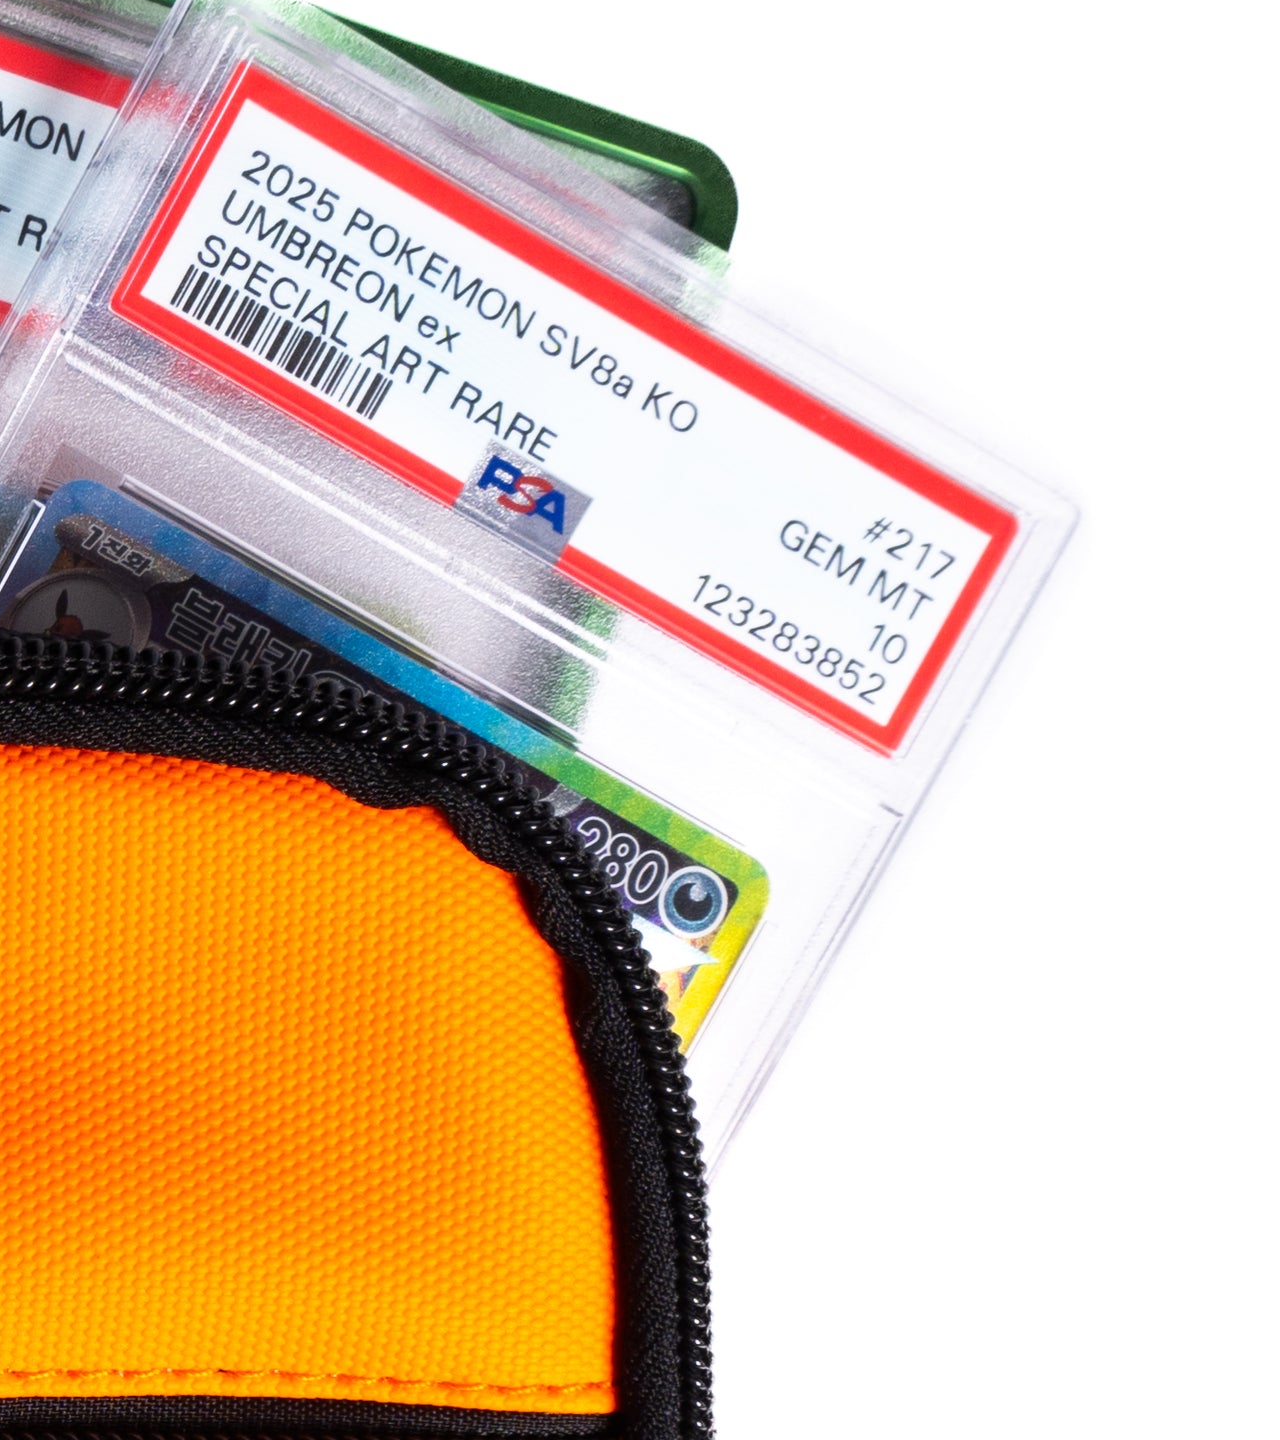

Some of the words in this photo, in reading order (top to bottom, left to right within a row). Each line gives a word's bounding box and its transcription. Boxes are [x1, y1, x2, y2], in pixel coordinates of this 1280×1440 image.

[221, 190, 415, 323] UMBREON
[416, 309, 462, 354] ex
[241, 150, 341, 223] 2025
[343, 207, 536, 338] POKEMON
[540, 324, 635, 399] SV8a
[641, 383, 699, 434] KO
[196, 234, 349, 348] SPECIAL
[360, 334, 449, 394] ART
[449, 381, 558, 462] RARE
[476, 455, 567, 535] PSA
[862, 516, 956, 580] #217
[779, 519, 867, 586] GEM
[867, 568, 934, 620] MT
[692, 573, 886, 706] 123283852
[868, 623, 908, 665] 10
